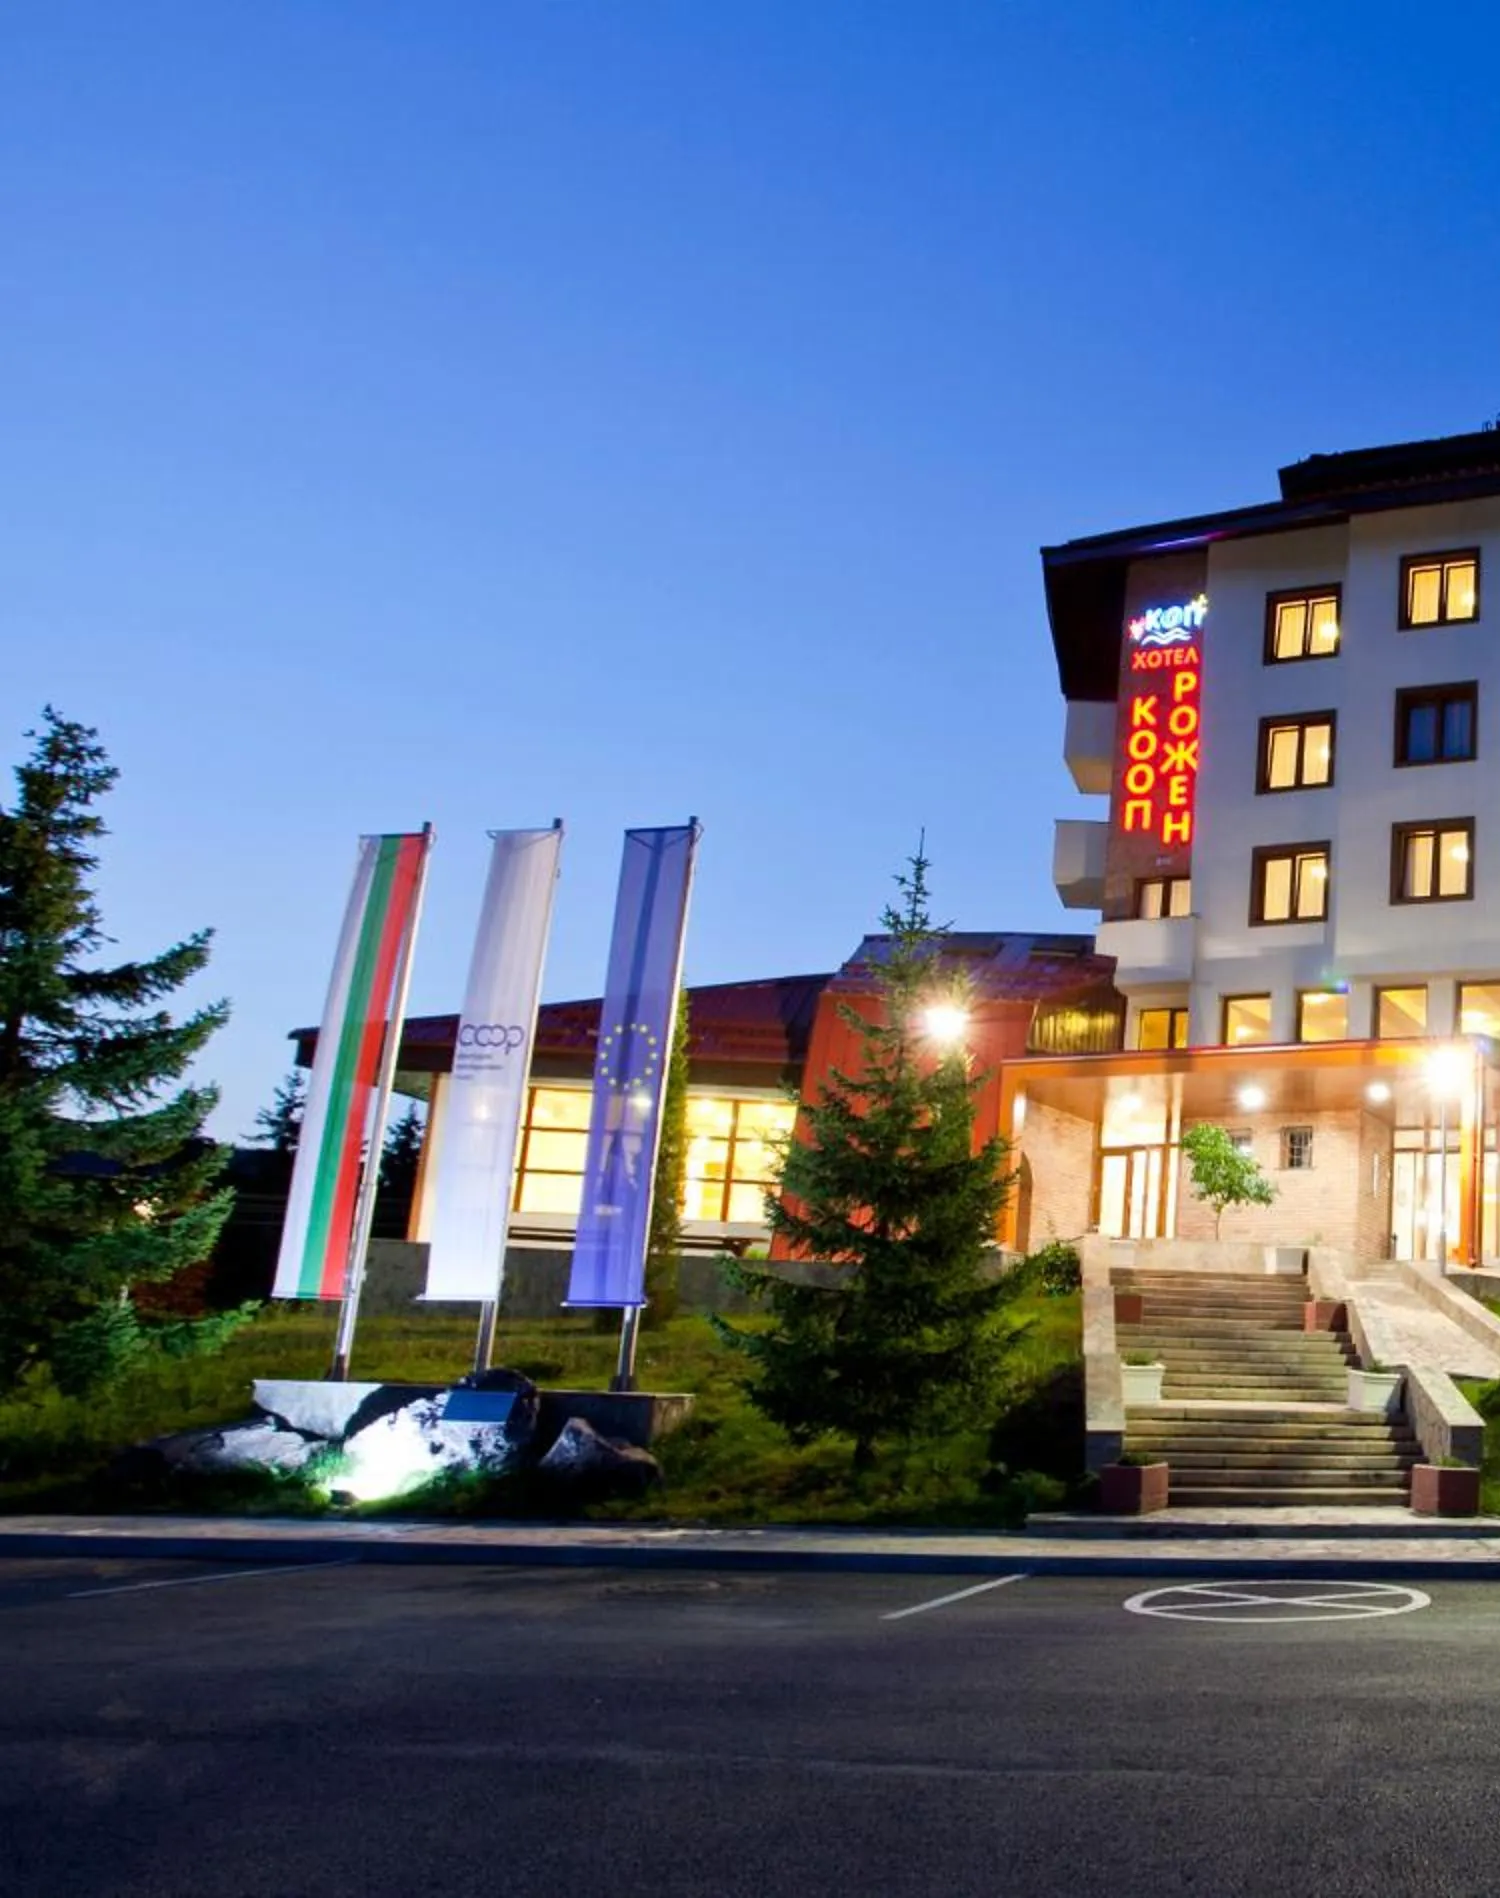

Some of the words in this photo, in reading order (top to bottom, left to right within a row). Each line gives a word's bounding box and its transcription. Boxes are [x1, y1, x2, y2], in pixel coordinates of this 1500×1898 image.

[1132, 647, 1199, 670] ХОТЕЛ
[1124, 695, 1157, 831] КООП
[1160, 671, 1198, 843] РОЖЕН
